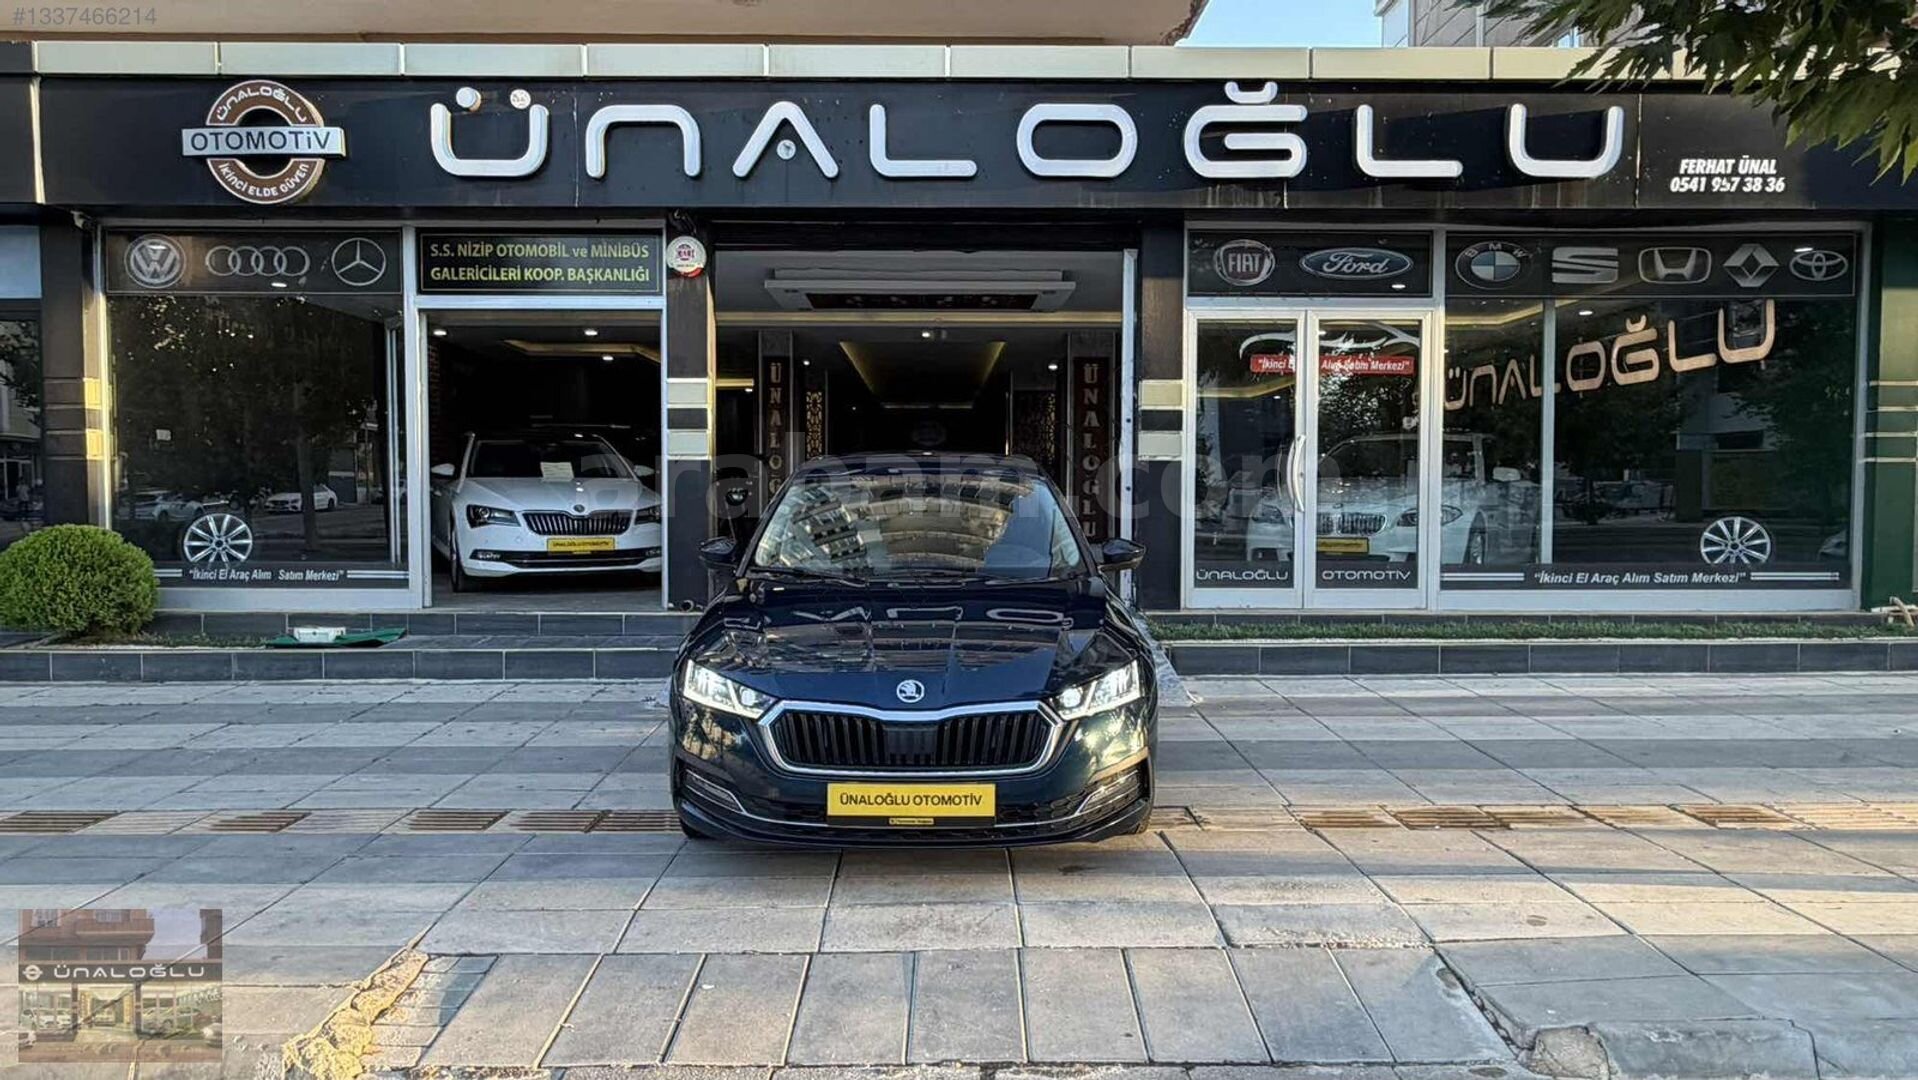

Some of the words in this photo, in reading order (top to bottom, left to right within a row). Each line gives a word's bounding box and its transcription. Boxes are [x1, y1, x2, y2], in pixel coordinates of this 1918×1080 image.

[430, 82, 1624, 179] ÜNALOĞLU
[1679, 158, 1736, 175] FERHAT
[1737, 154, 1778, 175] ÜNAL
[249, 186, 279, 198] ELDE
[1669, 176, 1707, 193] 0541
[1742, 176, 1764, 193] 38
[1764, 176, 1786, 193] 36
[430, 243, 455, 257] S.S.
[457, 241, 494, 258] NİZİP
[496, 241, 570, 259] OTOMOBİL
[573, 247, 588, 259] ve
[590, 242, 650, 259] MİNİBÜS
[1227, 252, 1262, 273] FIAT
[1321, 251, 1389, 276] Ford
[430, 264, 521, 281] GALERİCİLERİ
[523, 266, 565, 281] KOOP.
[568, 266, 650, 284] BAŞKANLIĞI
[1444, 299, 1776, 411] ÜNALOĞLU
[229, 569, 250, 582] Araç
[251, 569, 273, 581] Alım
[278, 569, 304, 581] Satım
[1196, 569, 1288, 581] ÜNALOĞLU
[1321, 568, 1411, 581] OTOMOTİV
[1575, 572, 1590, 584] El
[1591, 572, 1620, 586] Araç
[1621, 571, 1651, 584] Alım
[1653, 572, 1689, 584] Satım
[839, 791, 911, 807] ÜNALOĞLU
[912, 791, 983, 807] OTOMOTİV
